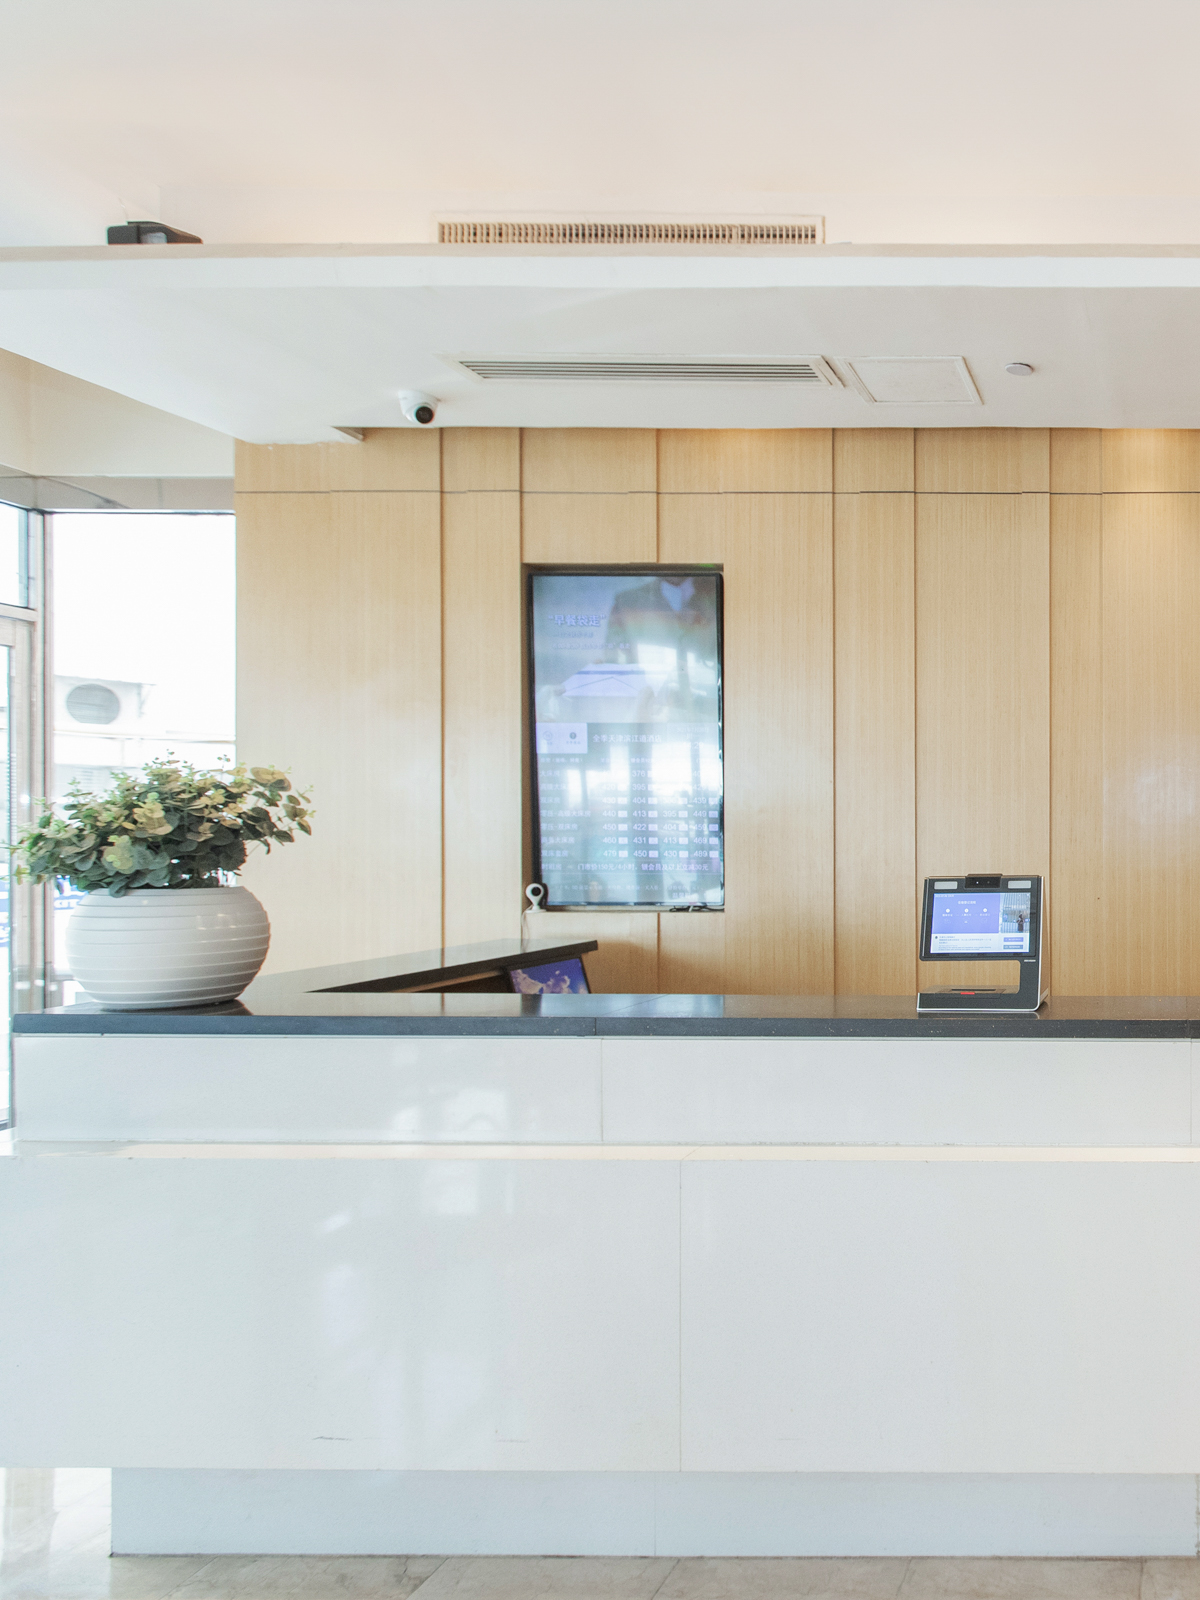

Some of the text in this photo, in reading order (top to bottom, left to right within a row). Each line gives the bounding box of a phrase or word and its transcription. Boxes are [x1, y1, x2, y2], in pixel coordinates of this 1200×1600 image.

[602, 810, 616, 818] 440
[632, 810, 646, 818] 413
[662, 810, 677, 818] 395
[693, 810, 707, 818] 449
[602, 850, 616, 858] 479
[632, 850, 646, 858] 450
[662, 850, 677, 858] 430
[693, 850, 707, 858] 489
